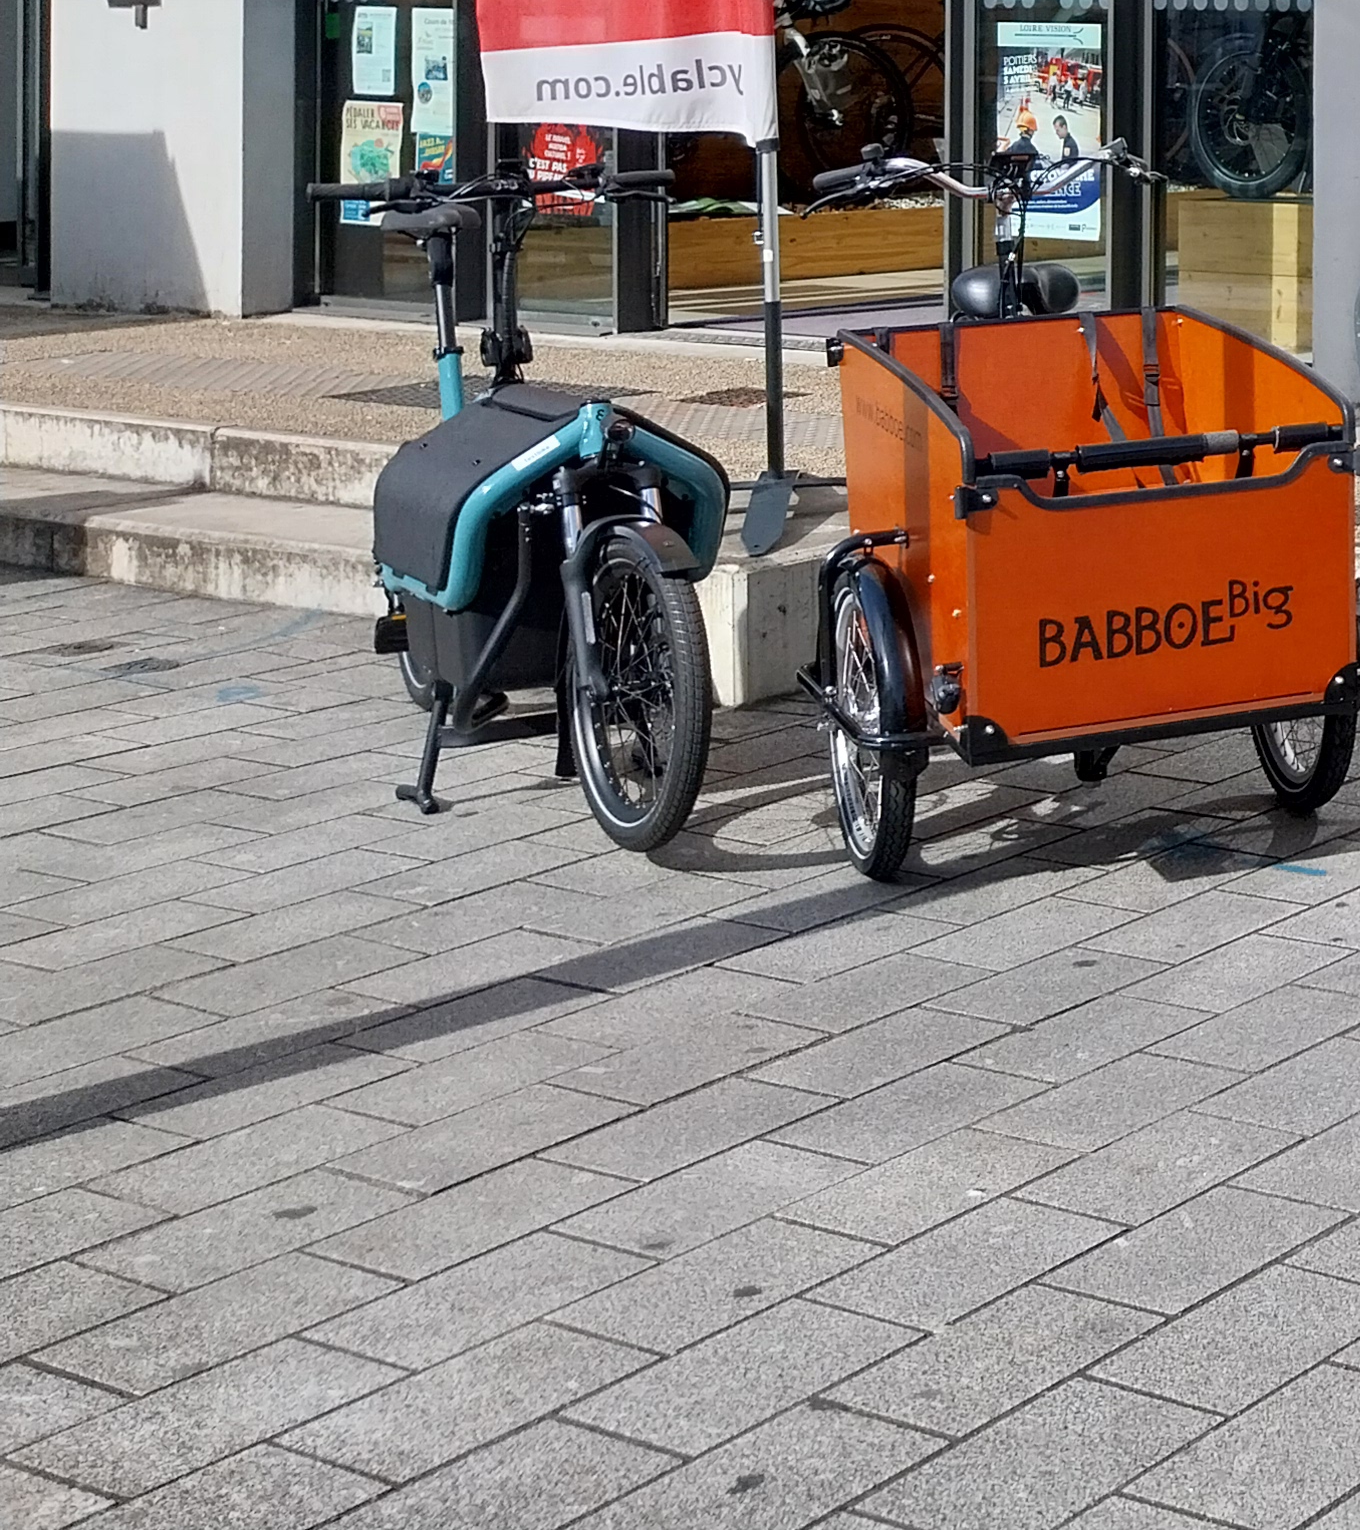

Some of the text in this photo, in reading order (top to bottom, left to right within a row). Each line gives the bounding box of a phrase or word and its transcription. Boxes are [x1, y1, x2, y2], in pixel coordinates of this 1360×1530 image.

[1020, 24, 1071, 33] LOIRE VISION
[1003, 54, 1037, 65] POITIERS
[1003, 64, 1032, 75] SAMEDI
[529, 156, 567, 173] C'EST PAS
[1039, 579, 1294, 668] BABBOE Big
